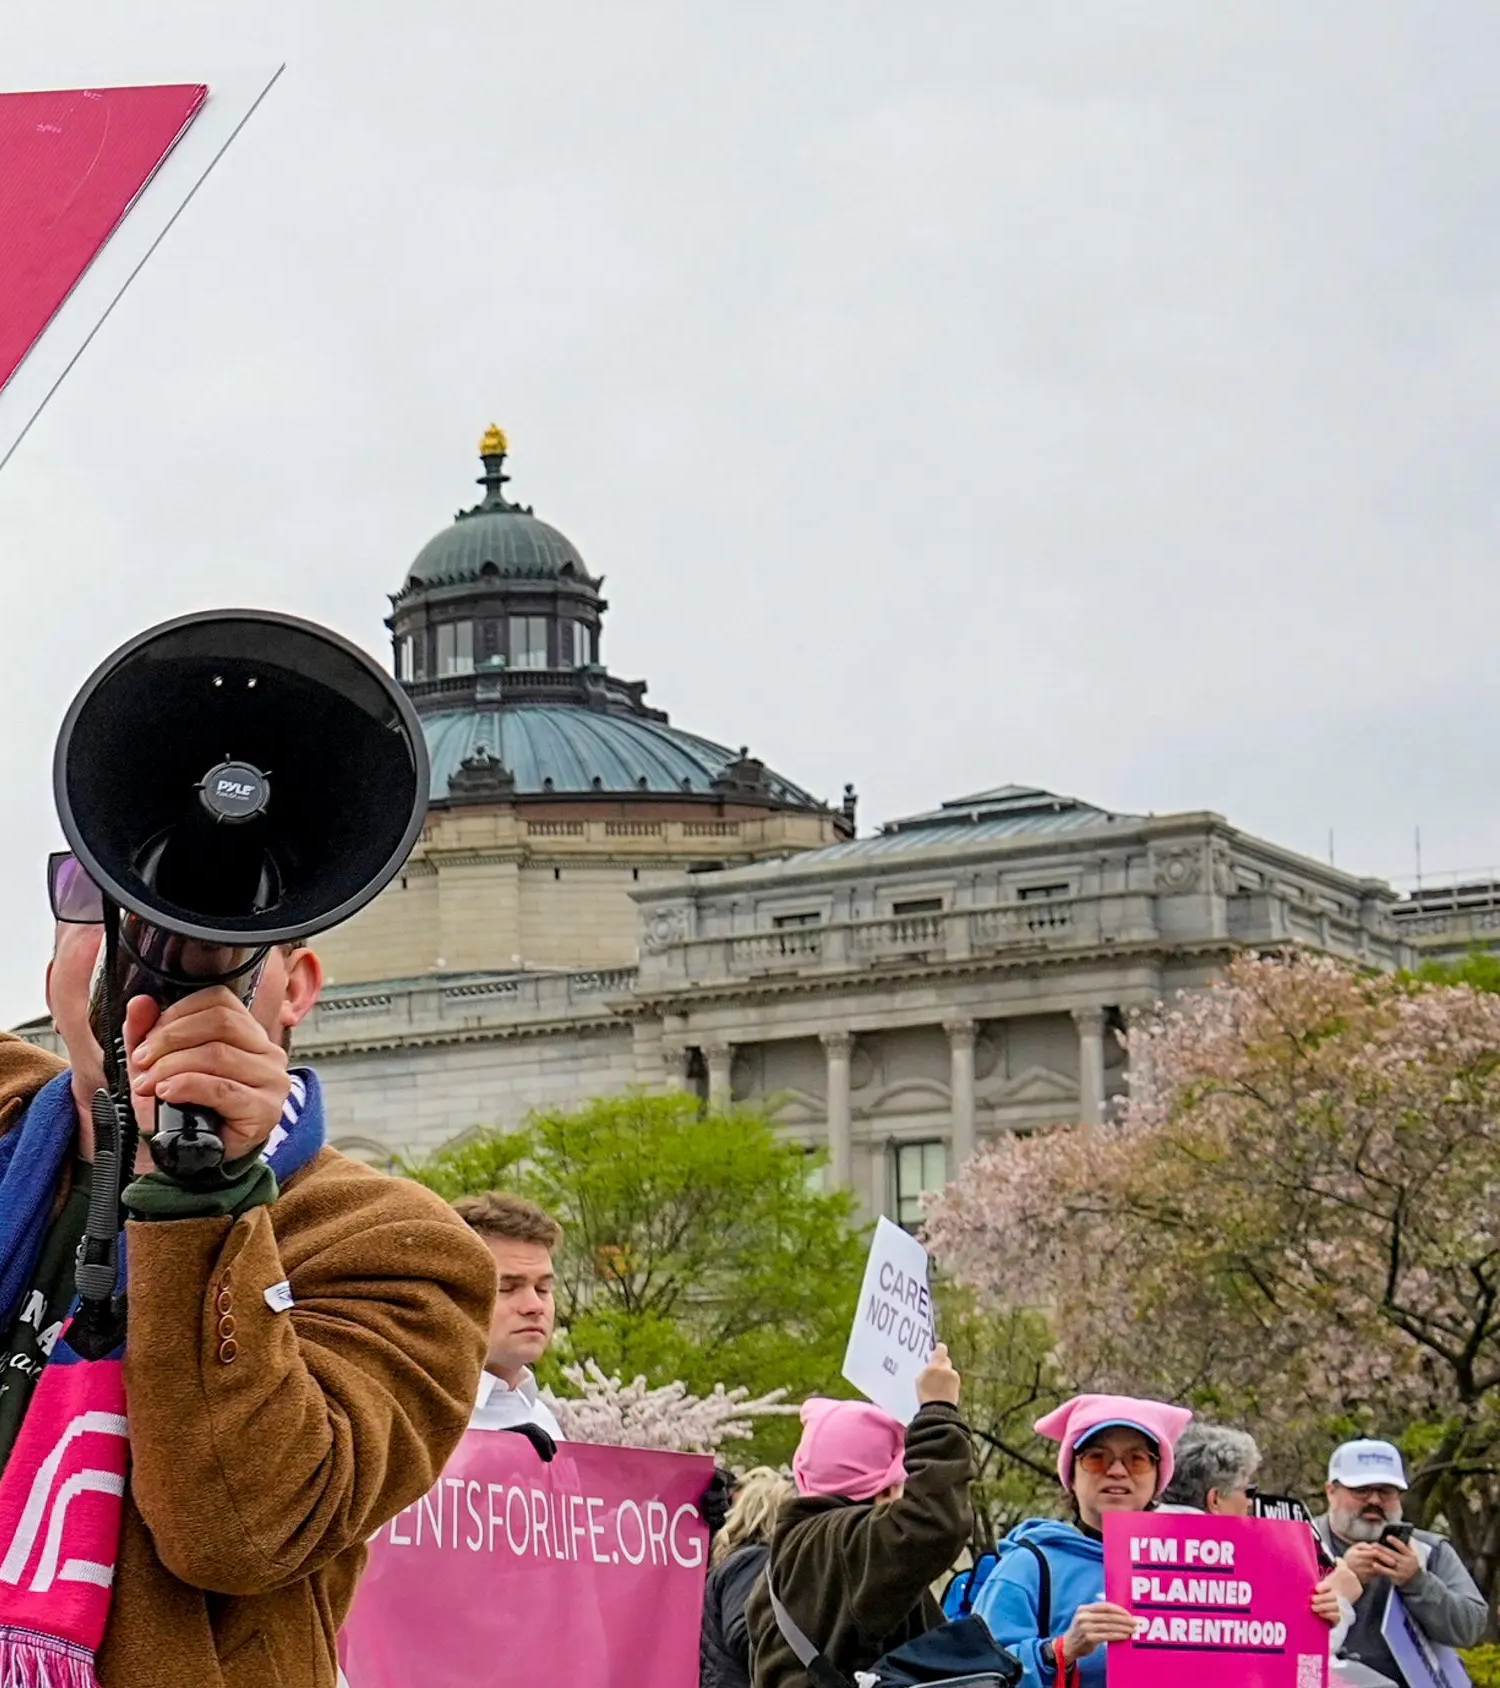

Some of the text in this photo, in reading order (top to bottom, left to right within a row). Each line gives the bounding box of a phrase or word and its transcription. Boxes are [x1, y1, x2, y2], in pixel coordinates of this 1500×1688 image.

[866, 1293, 899, 1337] NOT
[367, 1478, 703, 1568] ENTSFORLIFE.ORG
[1185, 1538, 1235, 1566] FOR
[1131, 1576, 1252, 1606] PLANNED
[1132, 1616, 1287, 1646] PARENTHOOD
